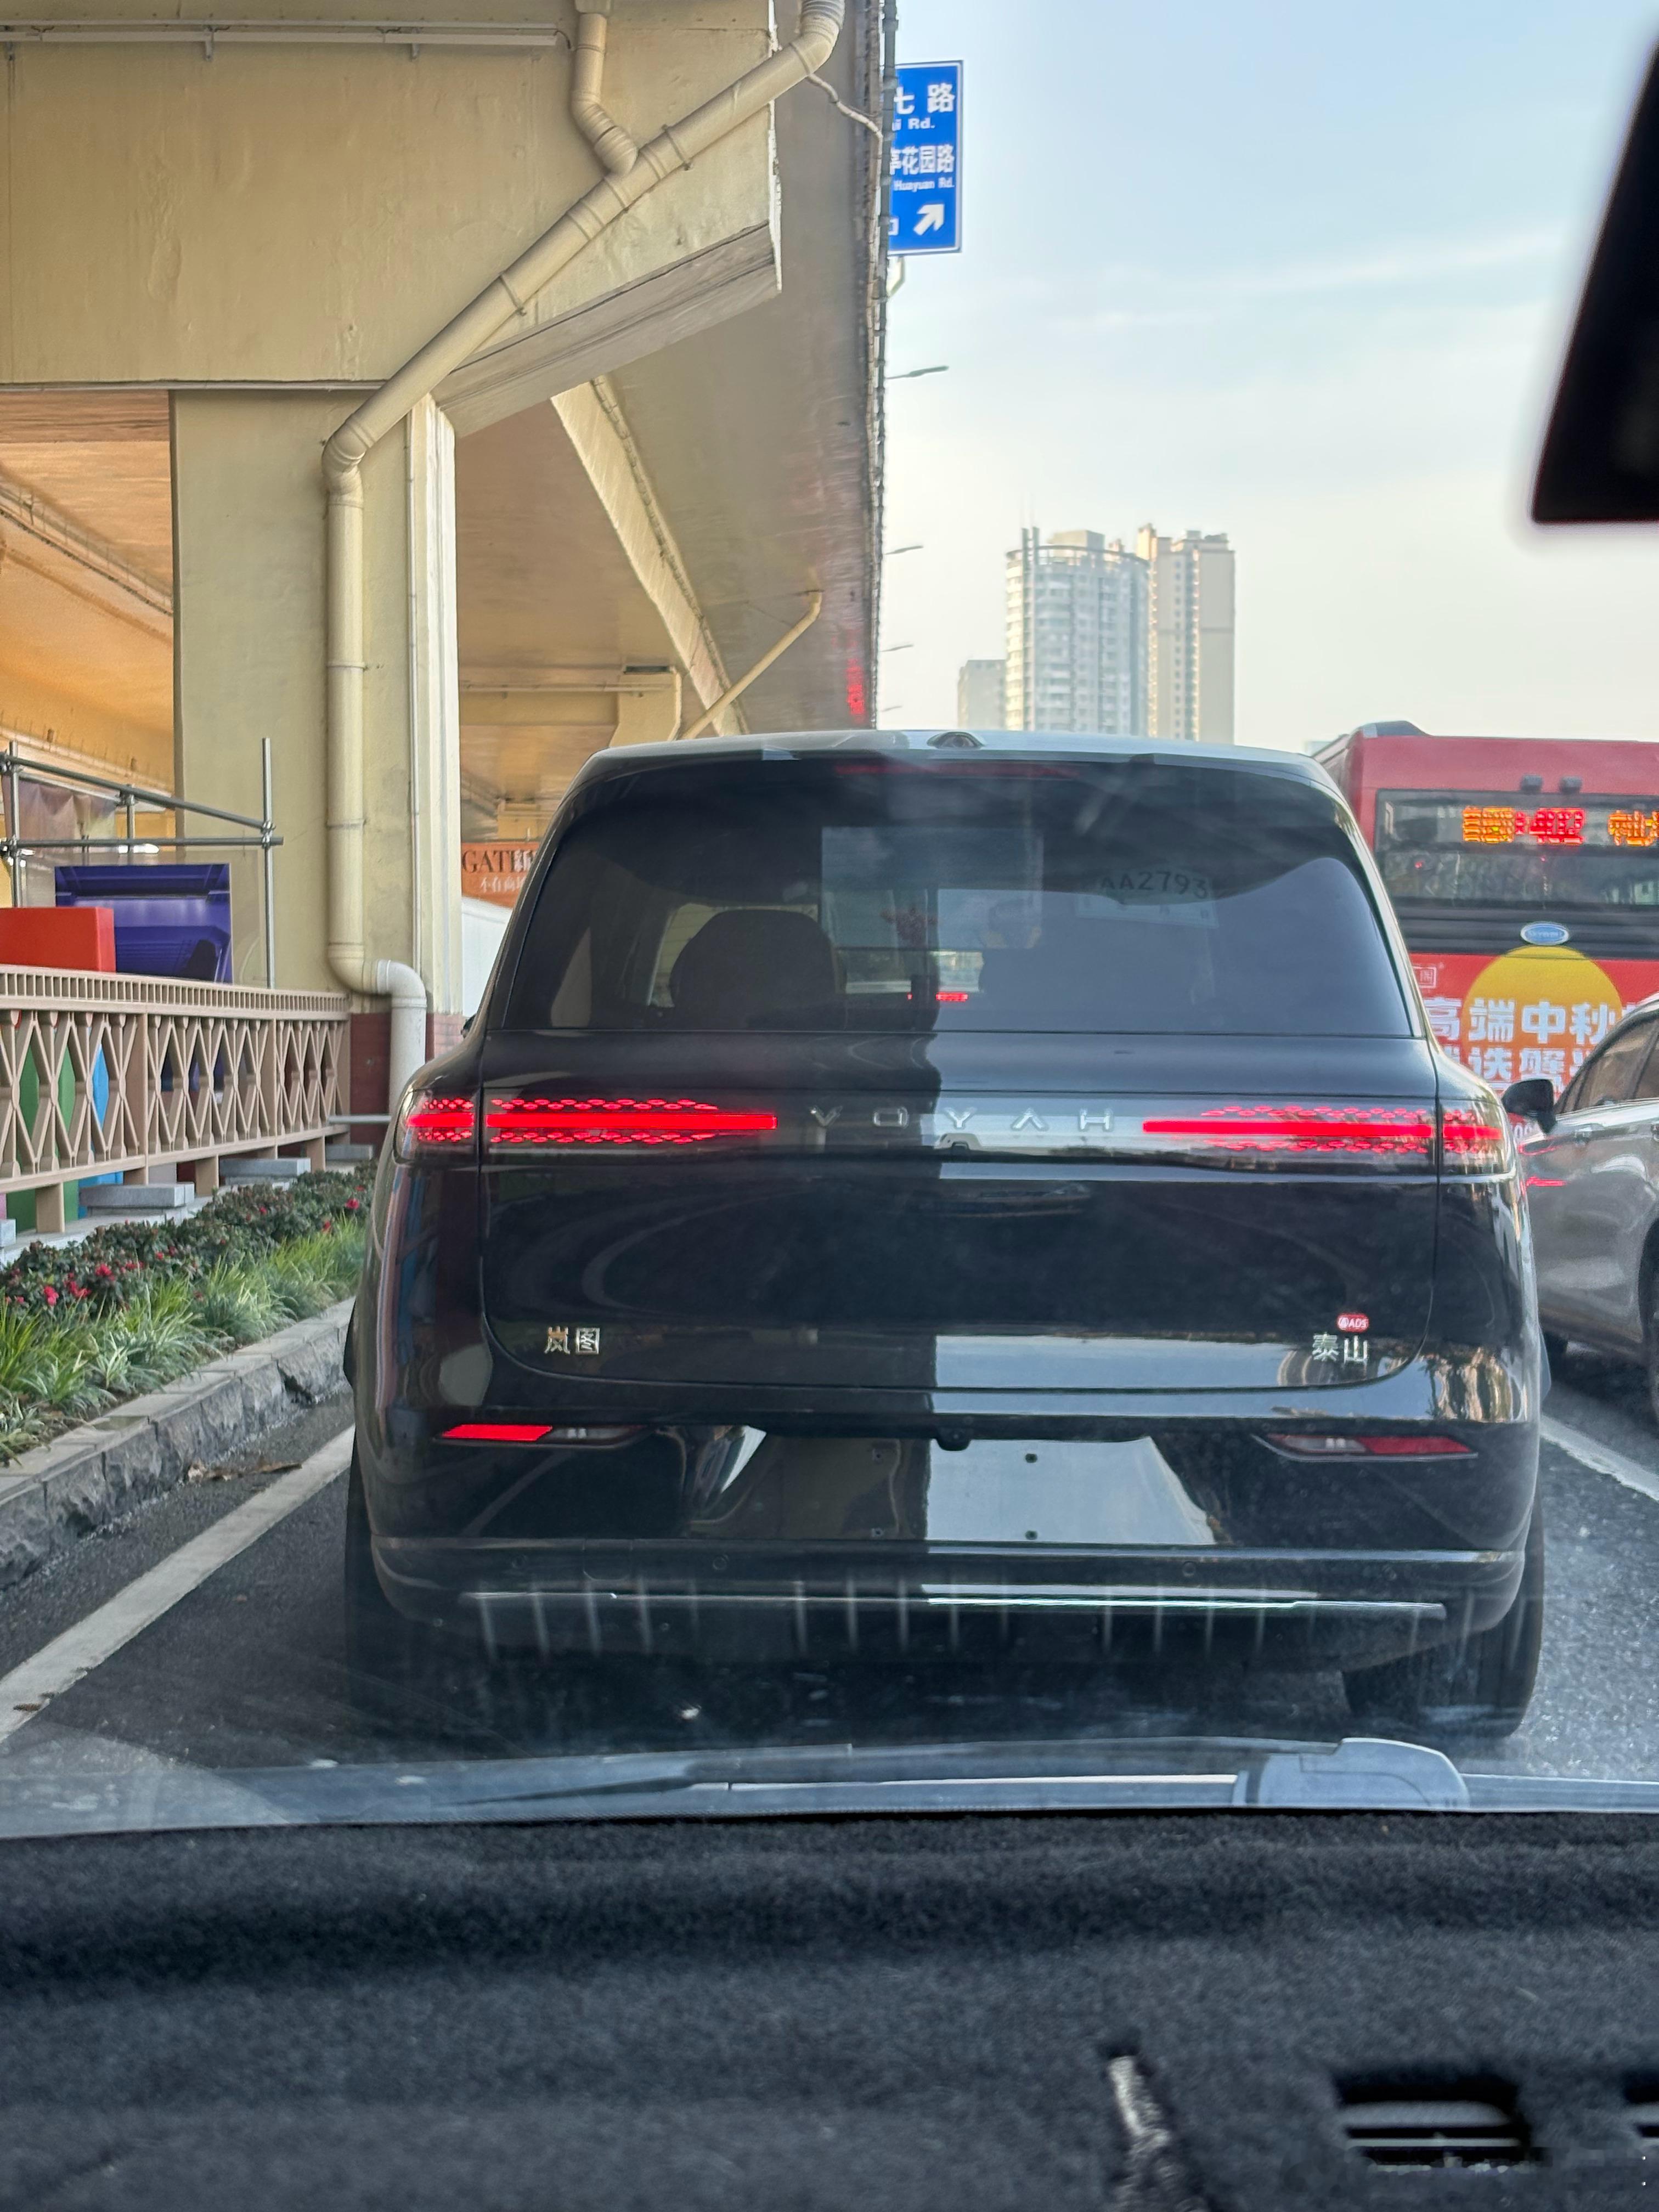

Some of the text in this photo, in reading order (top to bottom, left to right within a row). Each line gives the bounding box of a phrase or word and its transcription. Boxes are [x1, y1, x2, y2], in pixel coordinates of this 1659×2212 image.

[908, 117, 935, 129] Rd.
[938, 177, 955, 188] Rd.
[1423, 997, 1634, 1045] 高端中秋
[544, 1325, 601, 1355] 岚图
[1312, 1331, 1368, 1364] 泰山
